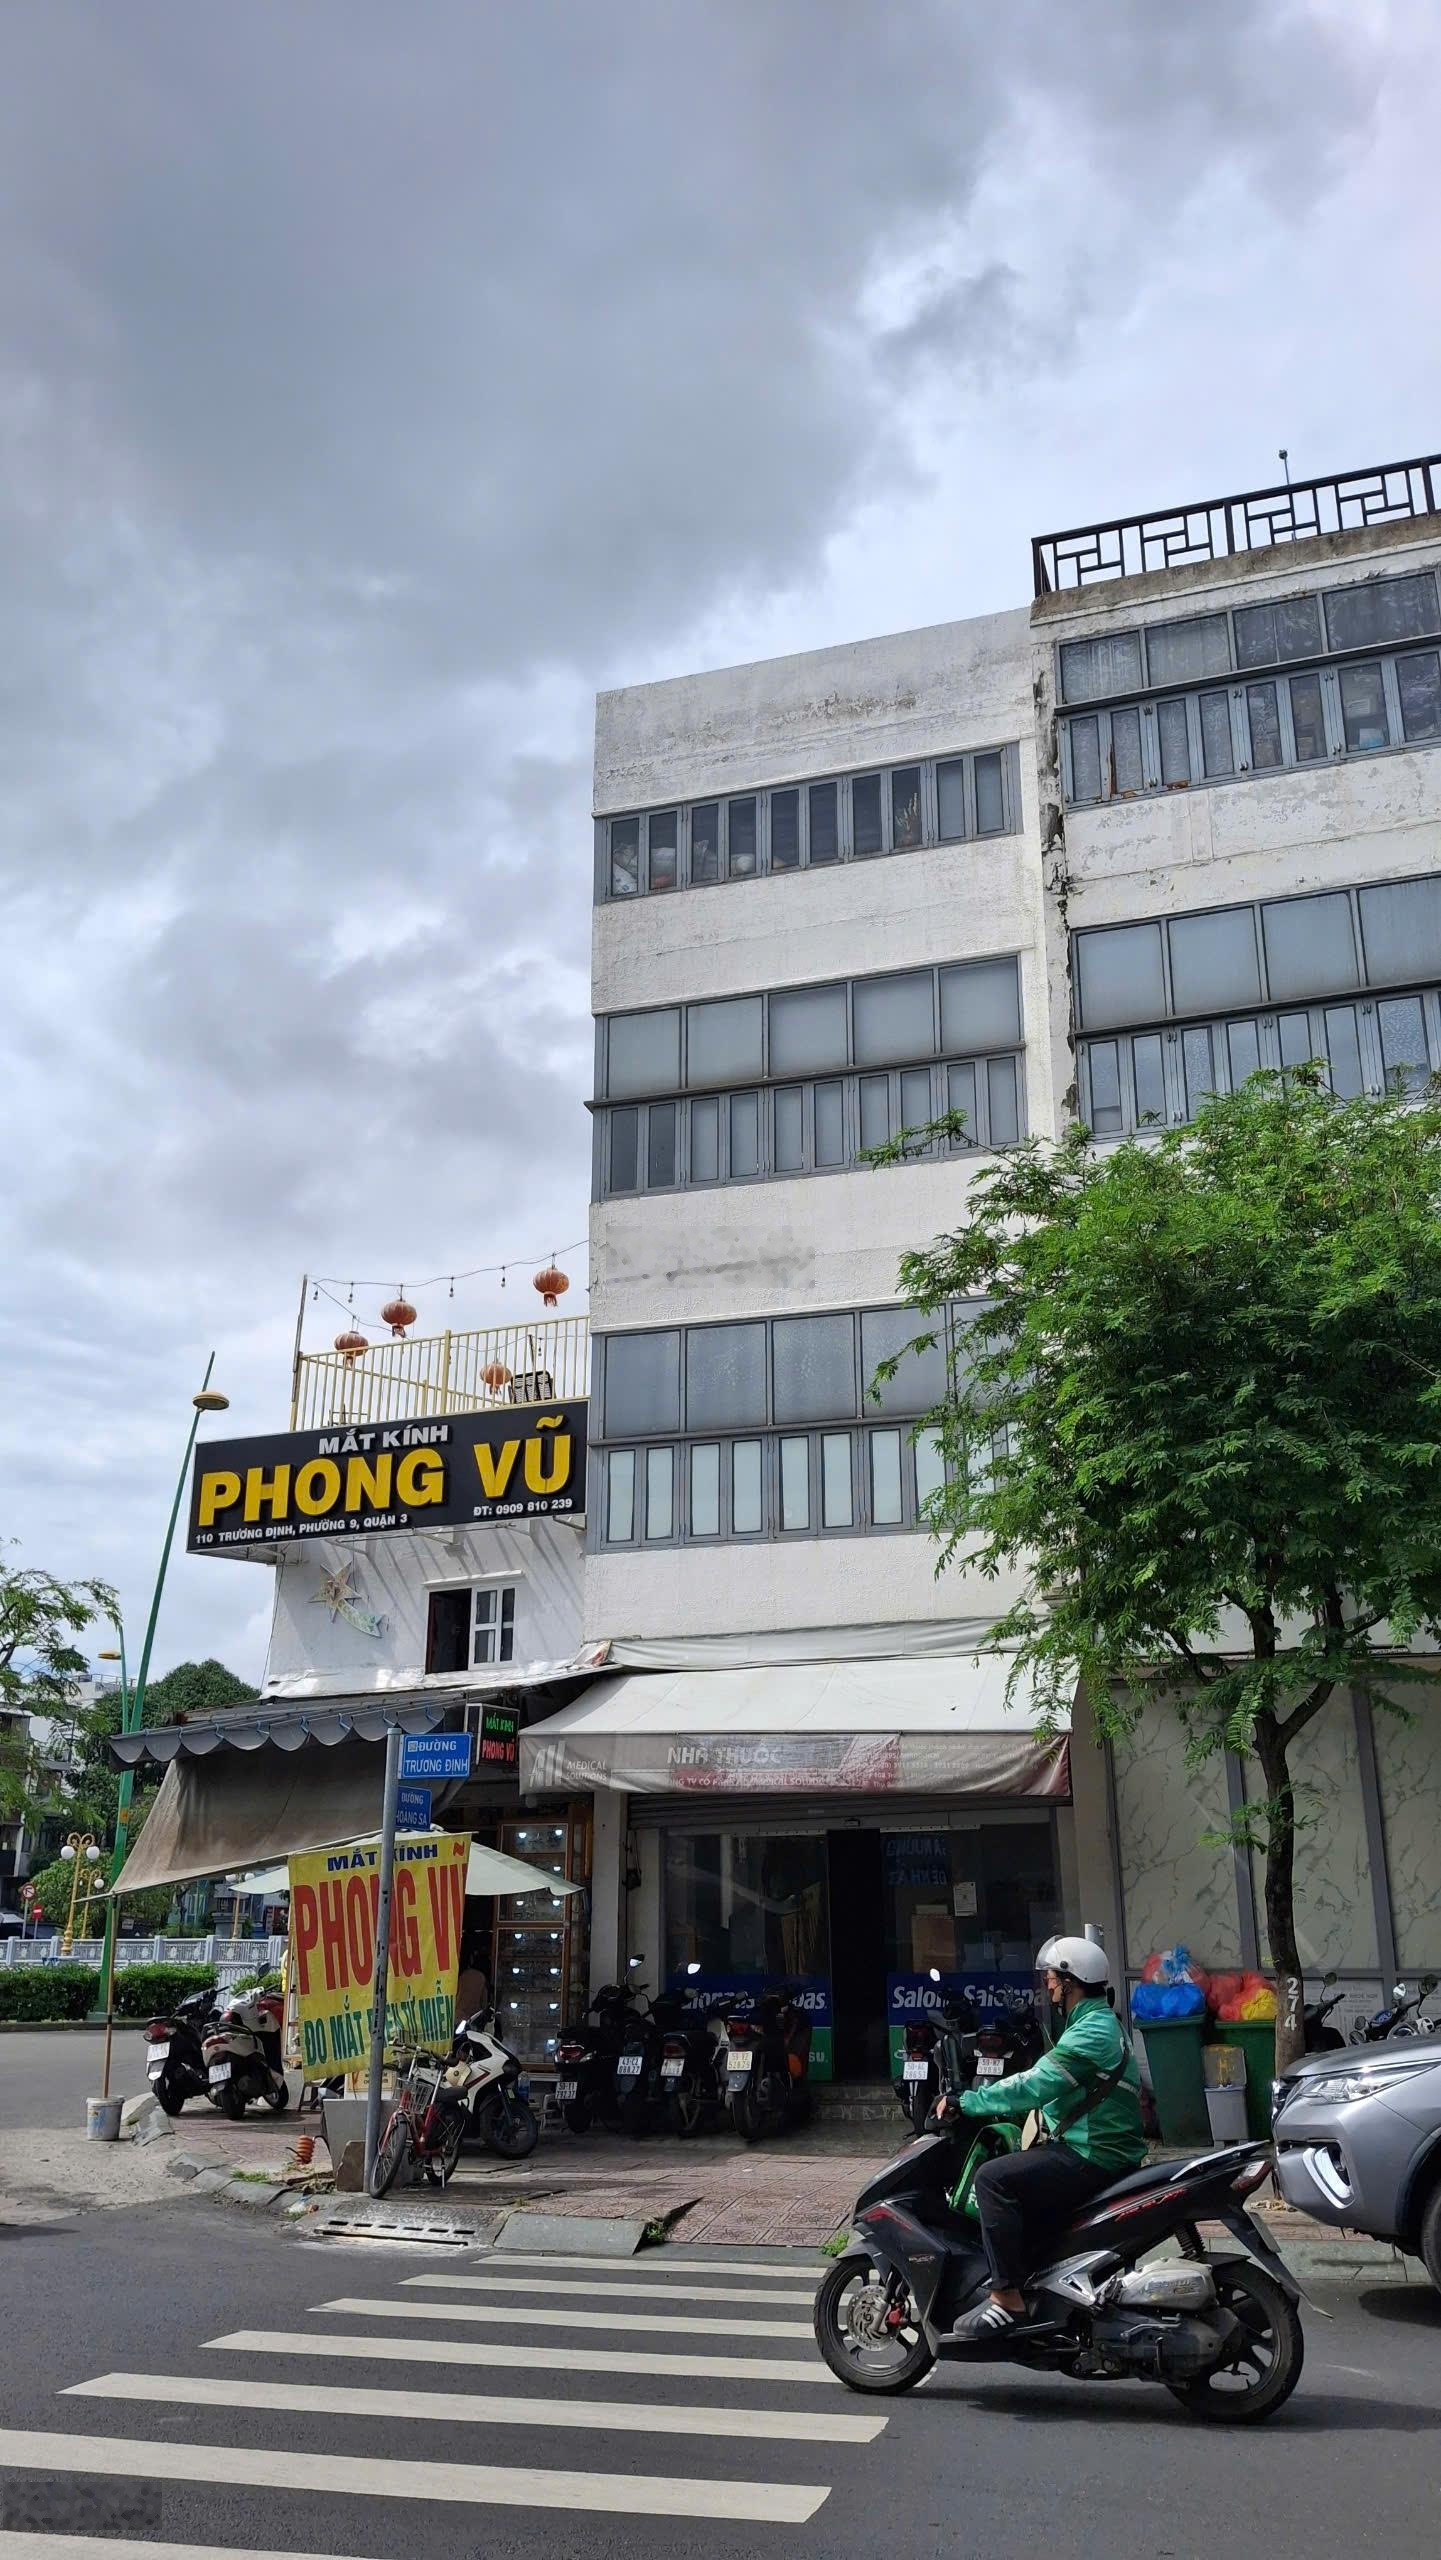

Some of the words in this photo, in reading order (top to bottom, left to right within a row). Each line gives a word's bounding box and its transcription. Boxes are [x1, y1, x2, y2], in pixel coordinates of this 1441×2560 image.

[318, 1427, 375, 1455] MẮT
[382, 1424, 449, 1448] KÍNH
[198, 1448, 446, 1527] PHONG
[473, 1415, 572, 1498] VŨ
[473, 1505, 493, 1517] ĐT:
[496, 1503, 524, 1515] 0909
[527, 1501, 548, 1512] 810
[551, 1498, 573, 1510] 239
[195, 1533, 214, 1544] 110
[265, 1524, 297, 1540] ĐỊNH,
[299, 1518, 346, 1533] PHƯỜNG
[349, 1519, 361, 1530] 9,
[363, 1514, 396, 1529] QUẬN
[400, 1514, 408, 1523] 3
[418, 1739, 457, 1752] ĐƯỜNG
[481, 1739, 505, 1760] PHONG
[445, 1758, 469, 1775] ĐỊNH
[566, 1760, 606, 1770] MEDICAL
[565, 1772, 607, 1782] SOLUTIONS
[401, 1791, 424, 1805] ĐƯỜNG
[418, 1812, 428, 1826] SA
[327, 1848, 378, 1872] MẮT
[330, 1995, 366, 2060] MẮT
